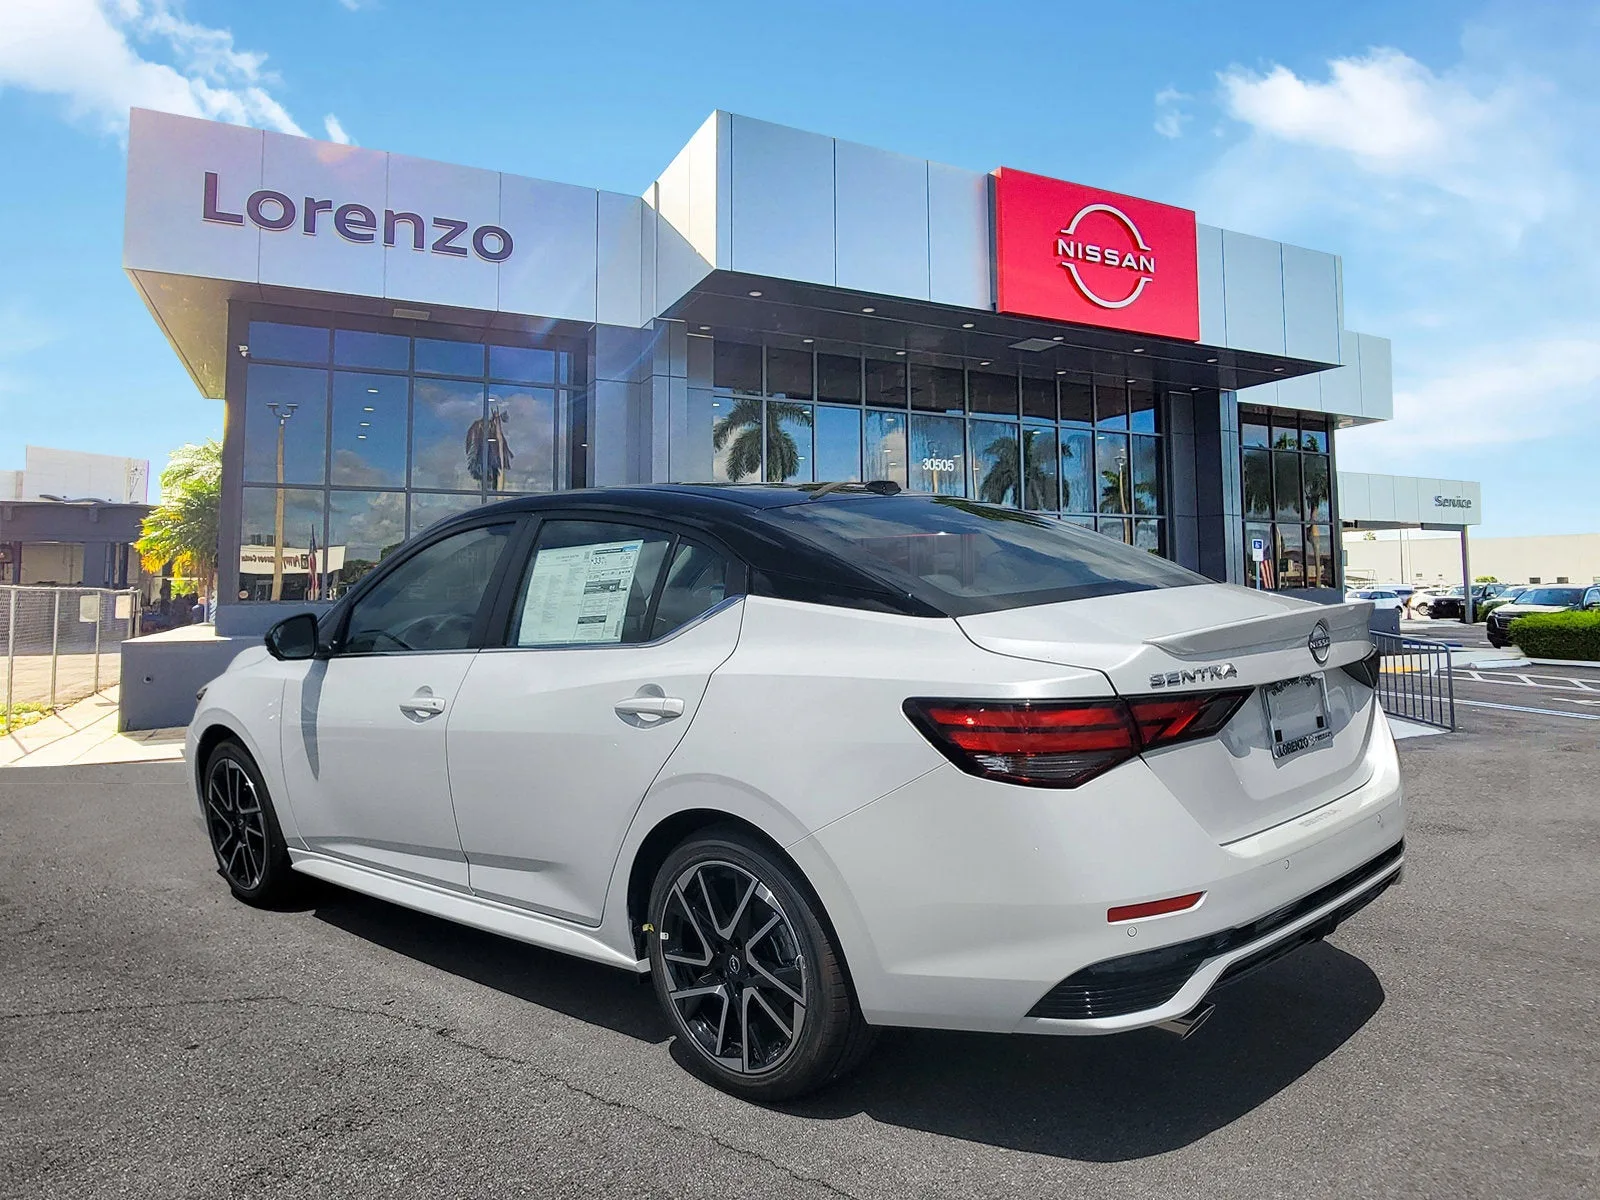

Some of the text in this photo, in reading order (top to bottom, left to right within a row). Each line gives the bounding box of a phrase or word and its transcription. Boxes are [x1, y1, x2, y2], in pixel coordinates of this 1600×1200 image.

[202, 171, 514, 262] Lorenzo
[1057, 238, 1155, 273] NISSAN
[922, 457, 955, 471] 30505
[1434, 495, 1472, 509] Service
[1150, 663, 1237, 690] SENTRA
